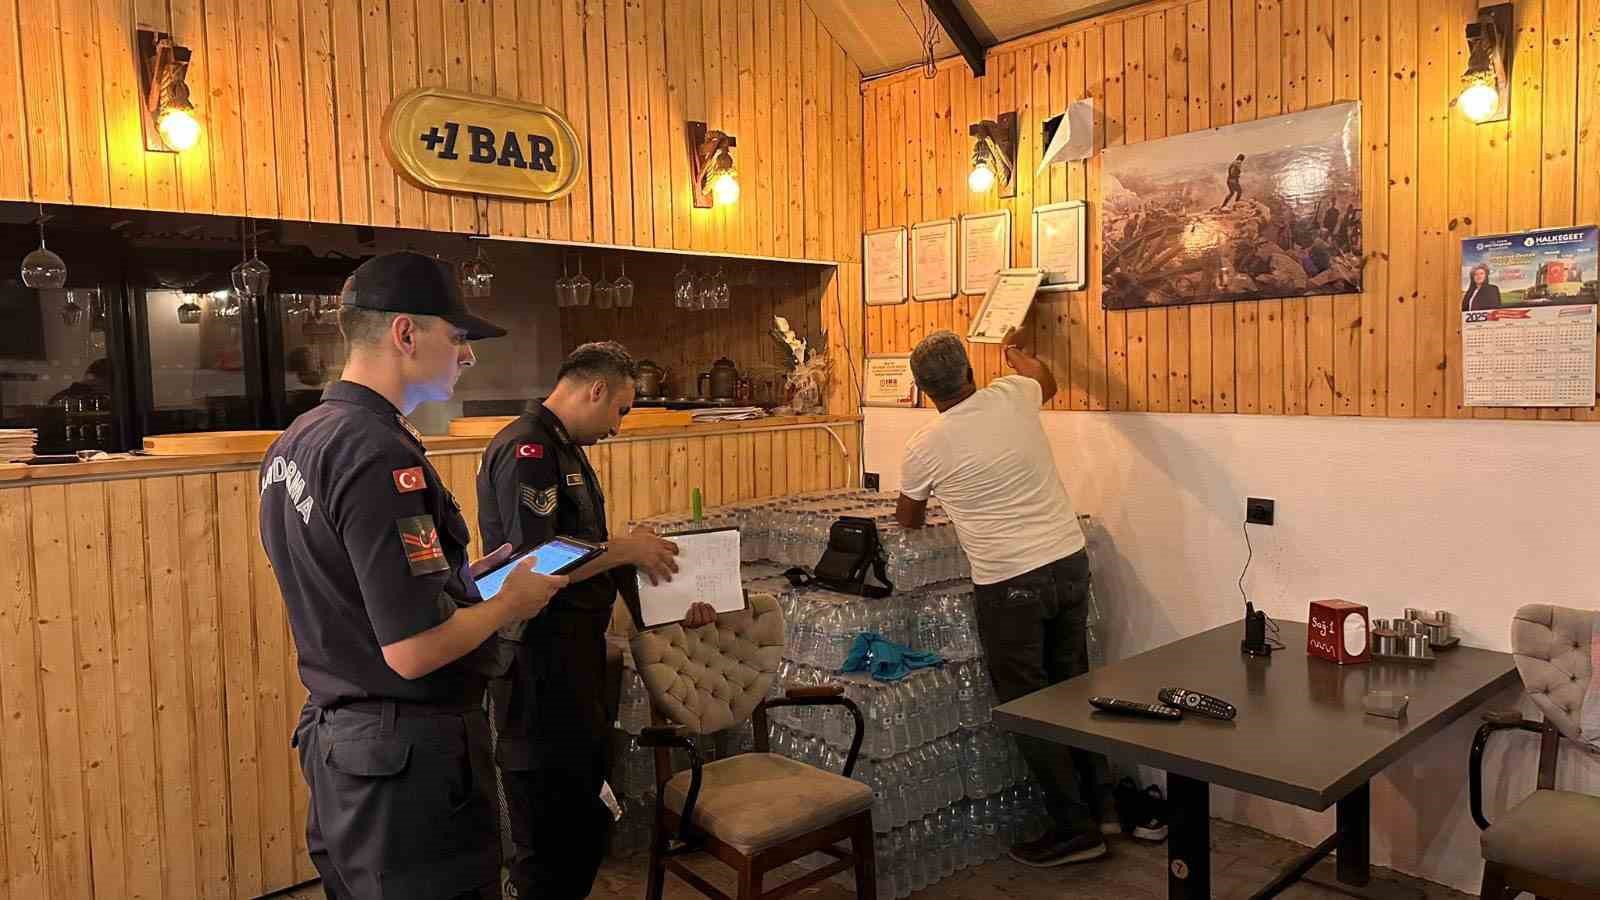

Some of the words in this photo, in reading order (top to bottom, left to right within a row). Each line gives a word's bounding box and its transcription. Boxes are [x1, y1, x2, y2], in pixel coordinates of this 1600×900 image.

[420, 122, 459, 160] +1
[467, 125, 557, 173] BAR
[1465, 312, 1488, 323] 2025
